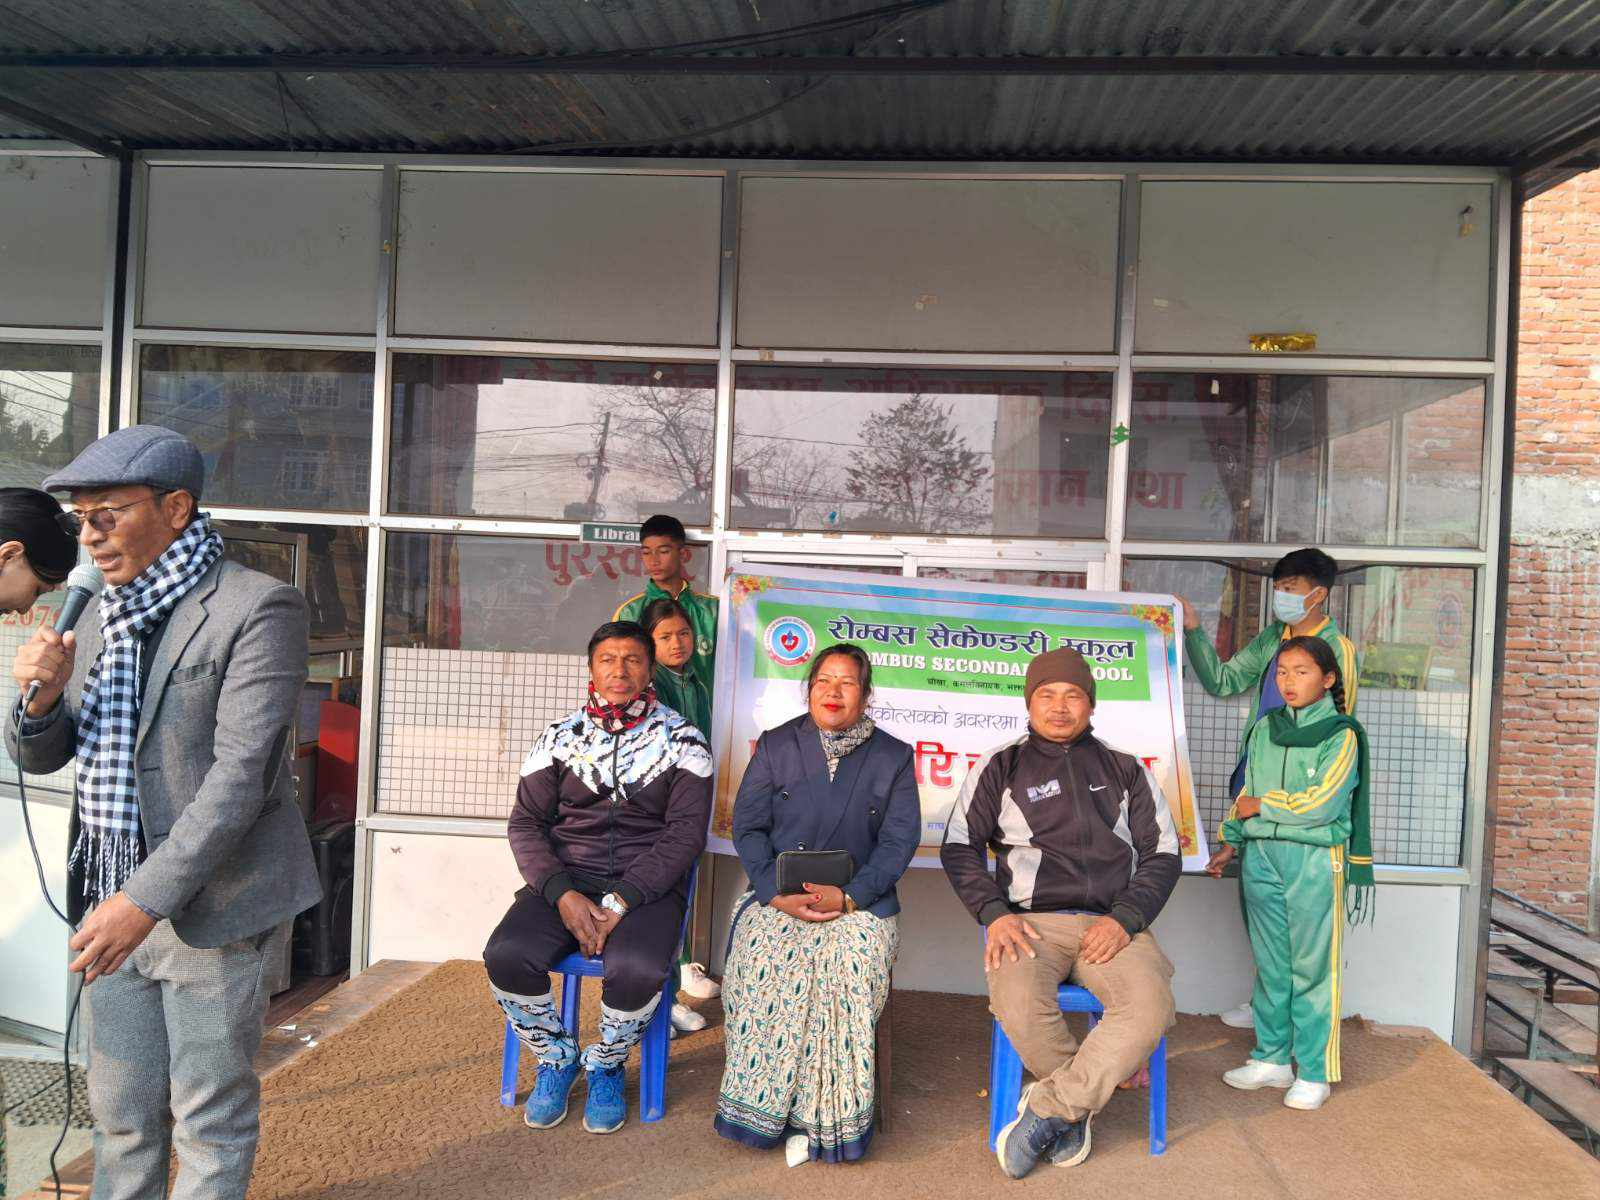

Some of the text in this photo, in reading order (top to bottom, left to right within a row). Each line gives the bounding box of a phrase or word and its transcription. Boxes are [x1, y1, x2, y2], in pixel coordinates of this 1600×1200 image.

[827, 615, 918, 646] रोम्बस
[867, 651, 926, 670] MBUS
[931, 656, 1030, 678] SECONDA
